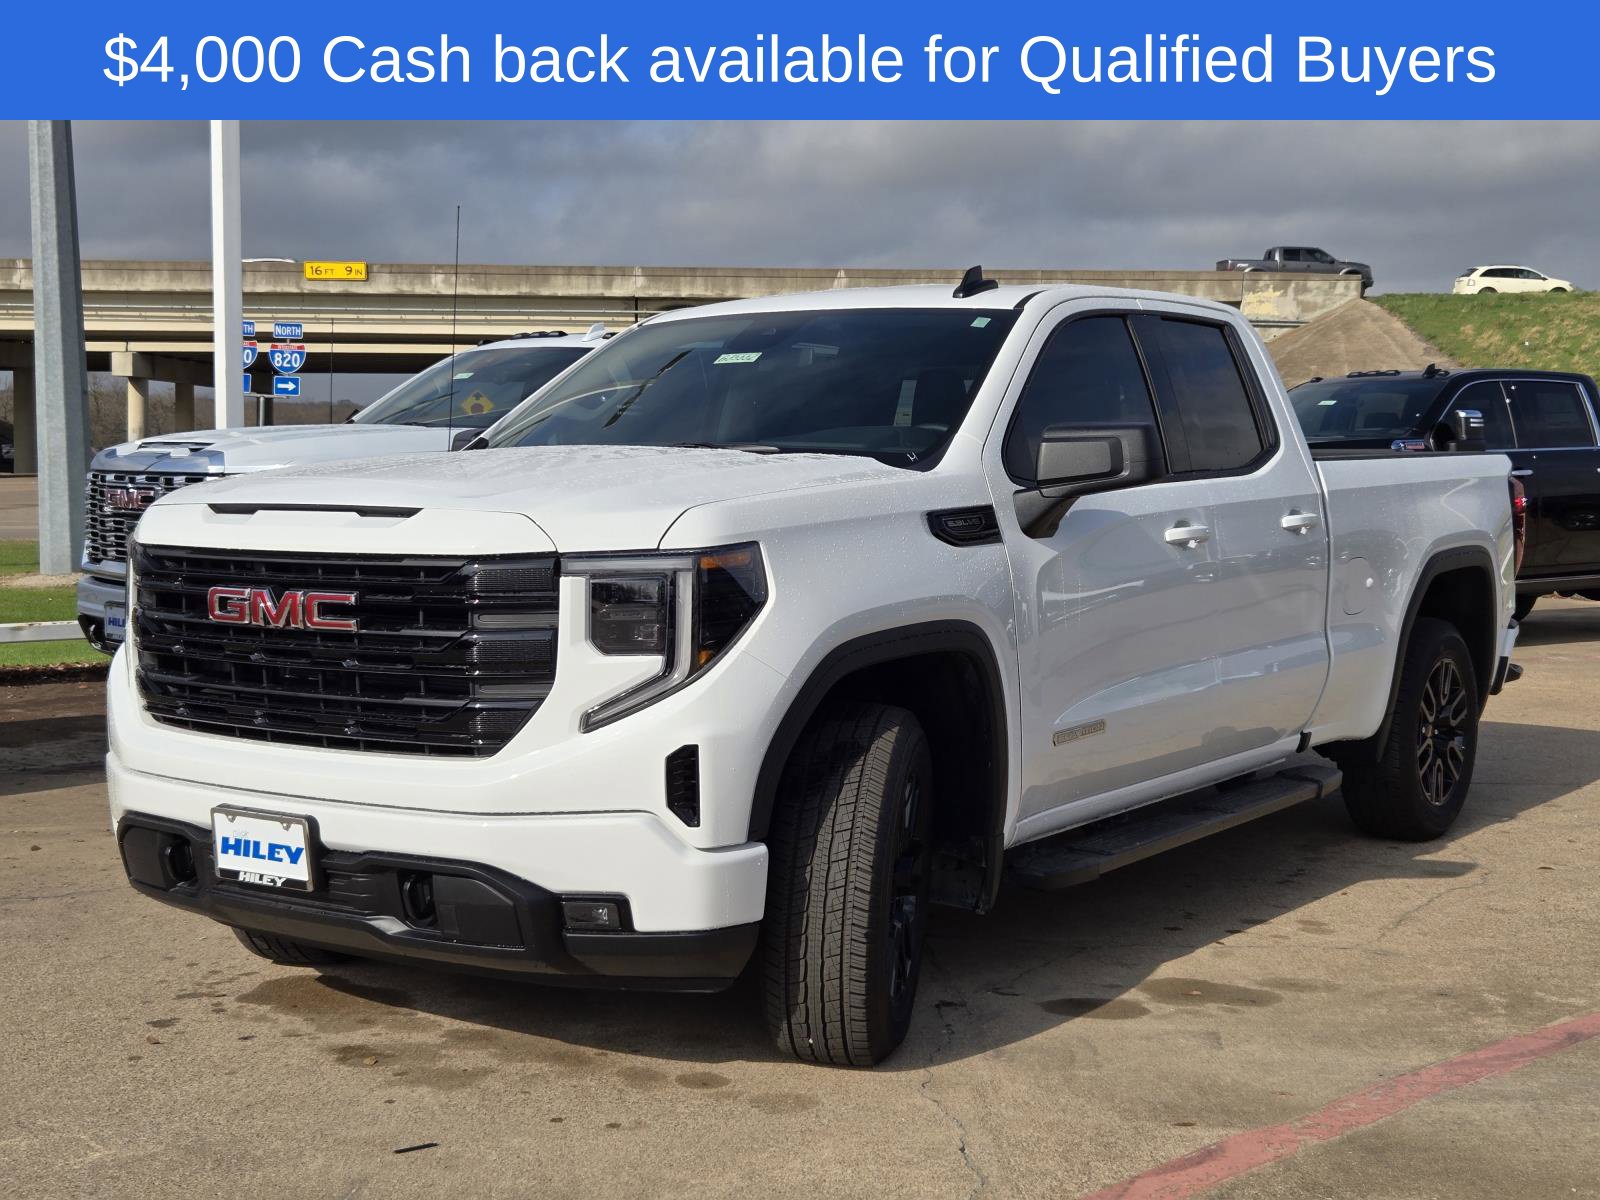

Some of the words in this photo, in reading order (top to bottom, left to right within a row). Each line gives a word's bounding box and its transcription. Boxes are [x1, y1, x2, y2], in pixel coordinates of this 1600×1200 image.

[310, 265, 323, 276] 16
[324, 268, 336, 276] FT
[344, 265, 353, 276] 9
[354, 268, 363, 276] IN
[275, 325, 301, 336] NORTH
[274, 352, 301, 368] 820
[106, 487, 155, 510] GMC
[207, 586, 359, 633] GMC
[220, 836, 305, 865] HILEY
[238, 871, 288, 887] HILEY
